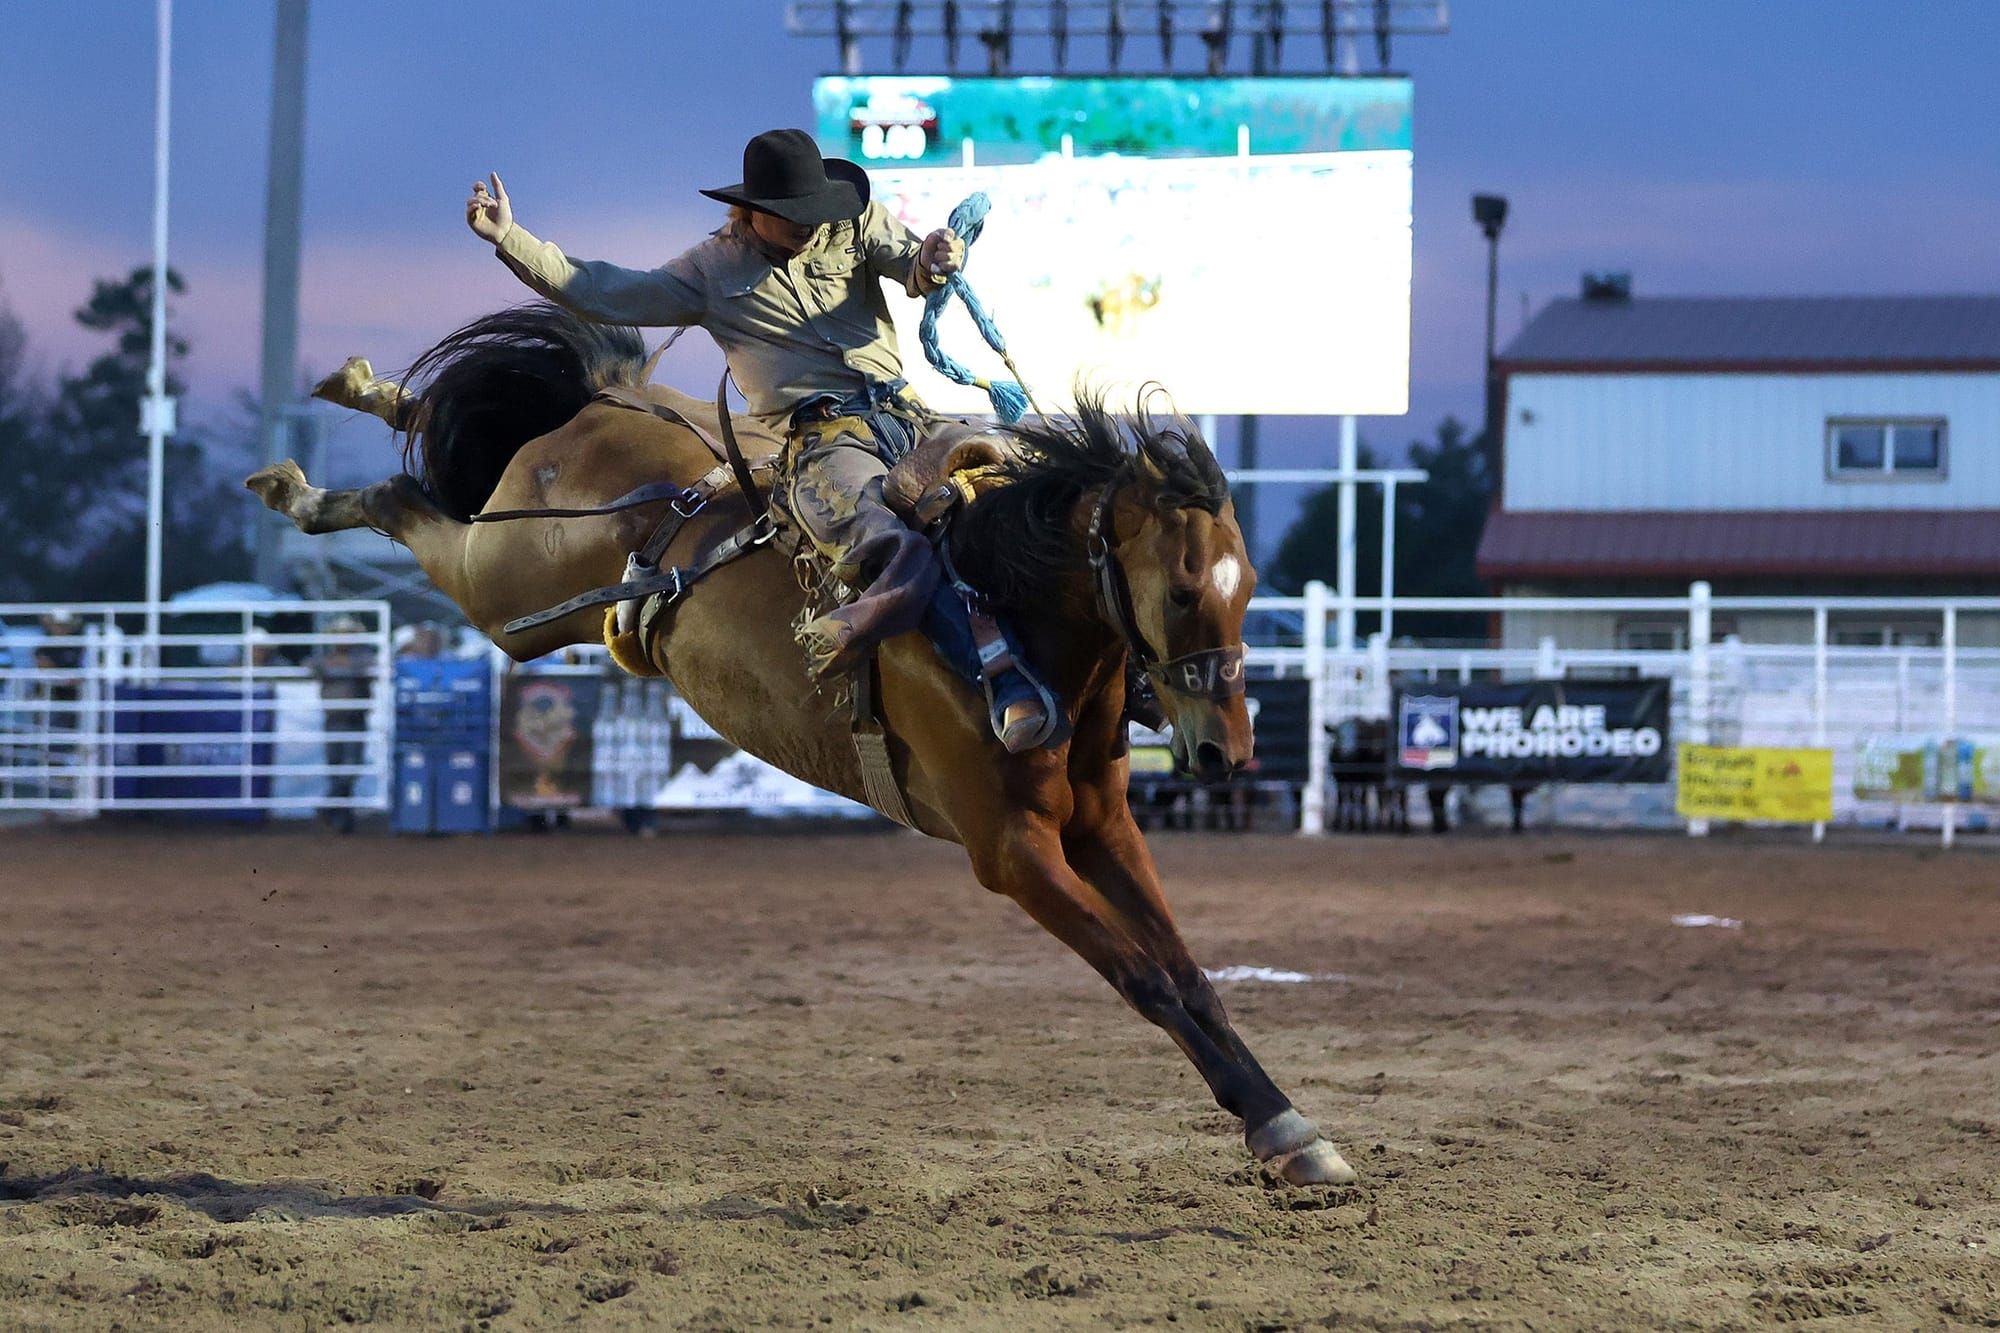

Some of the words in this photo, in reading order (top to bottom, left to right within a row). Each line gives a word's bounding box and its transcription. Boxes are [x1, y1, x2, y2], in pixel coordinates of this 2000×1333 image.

[1461, 706, 1523, 731] WE
[1530, 704, 1606, 728] ARE
[1461, 726, 1662, 758] PRORODEO
